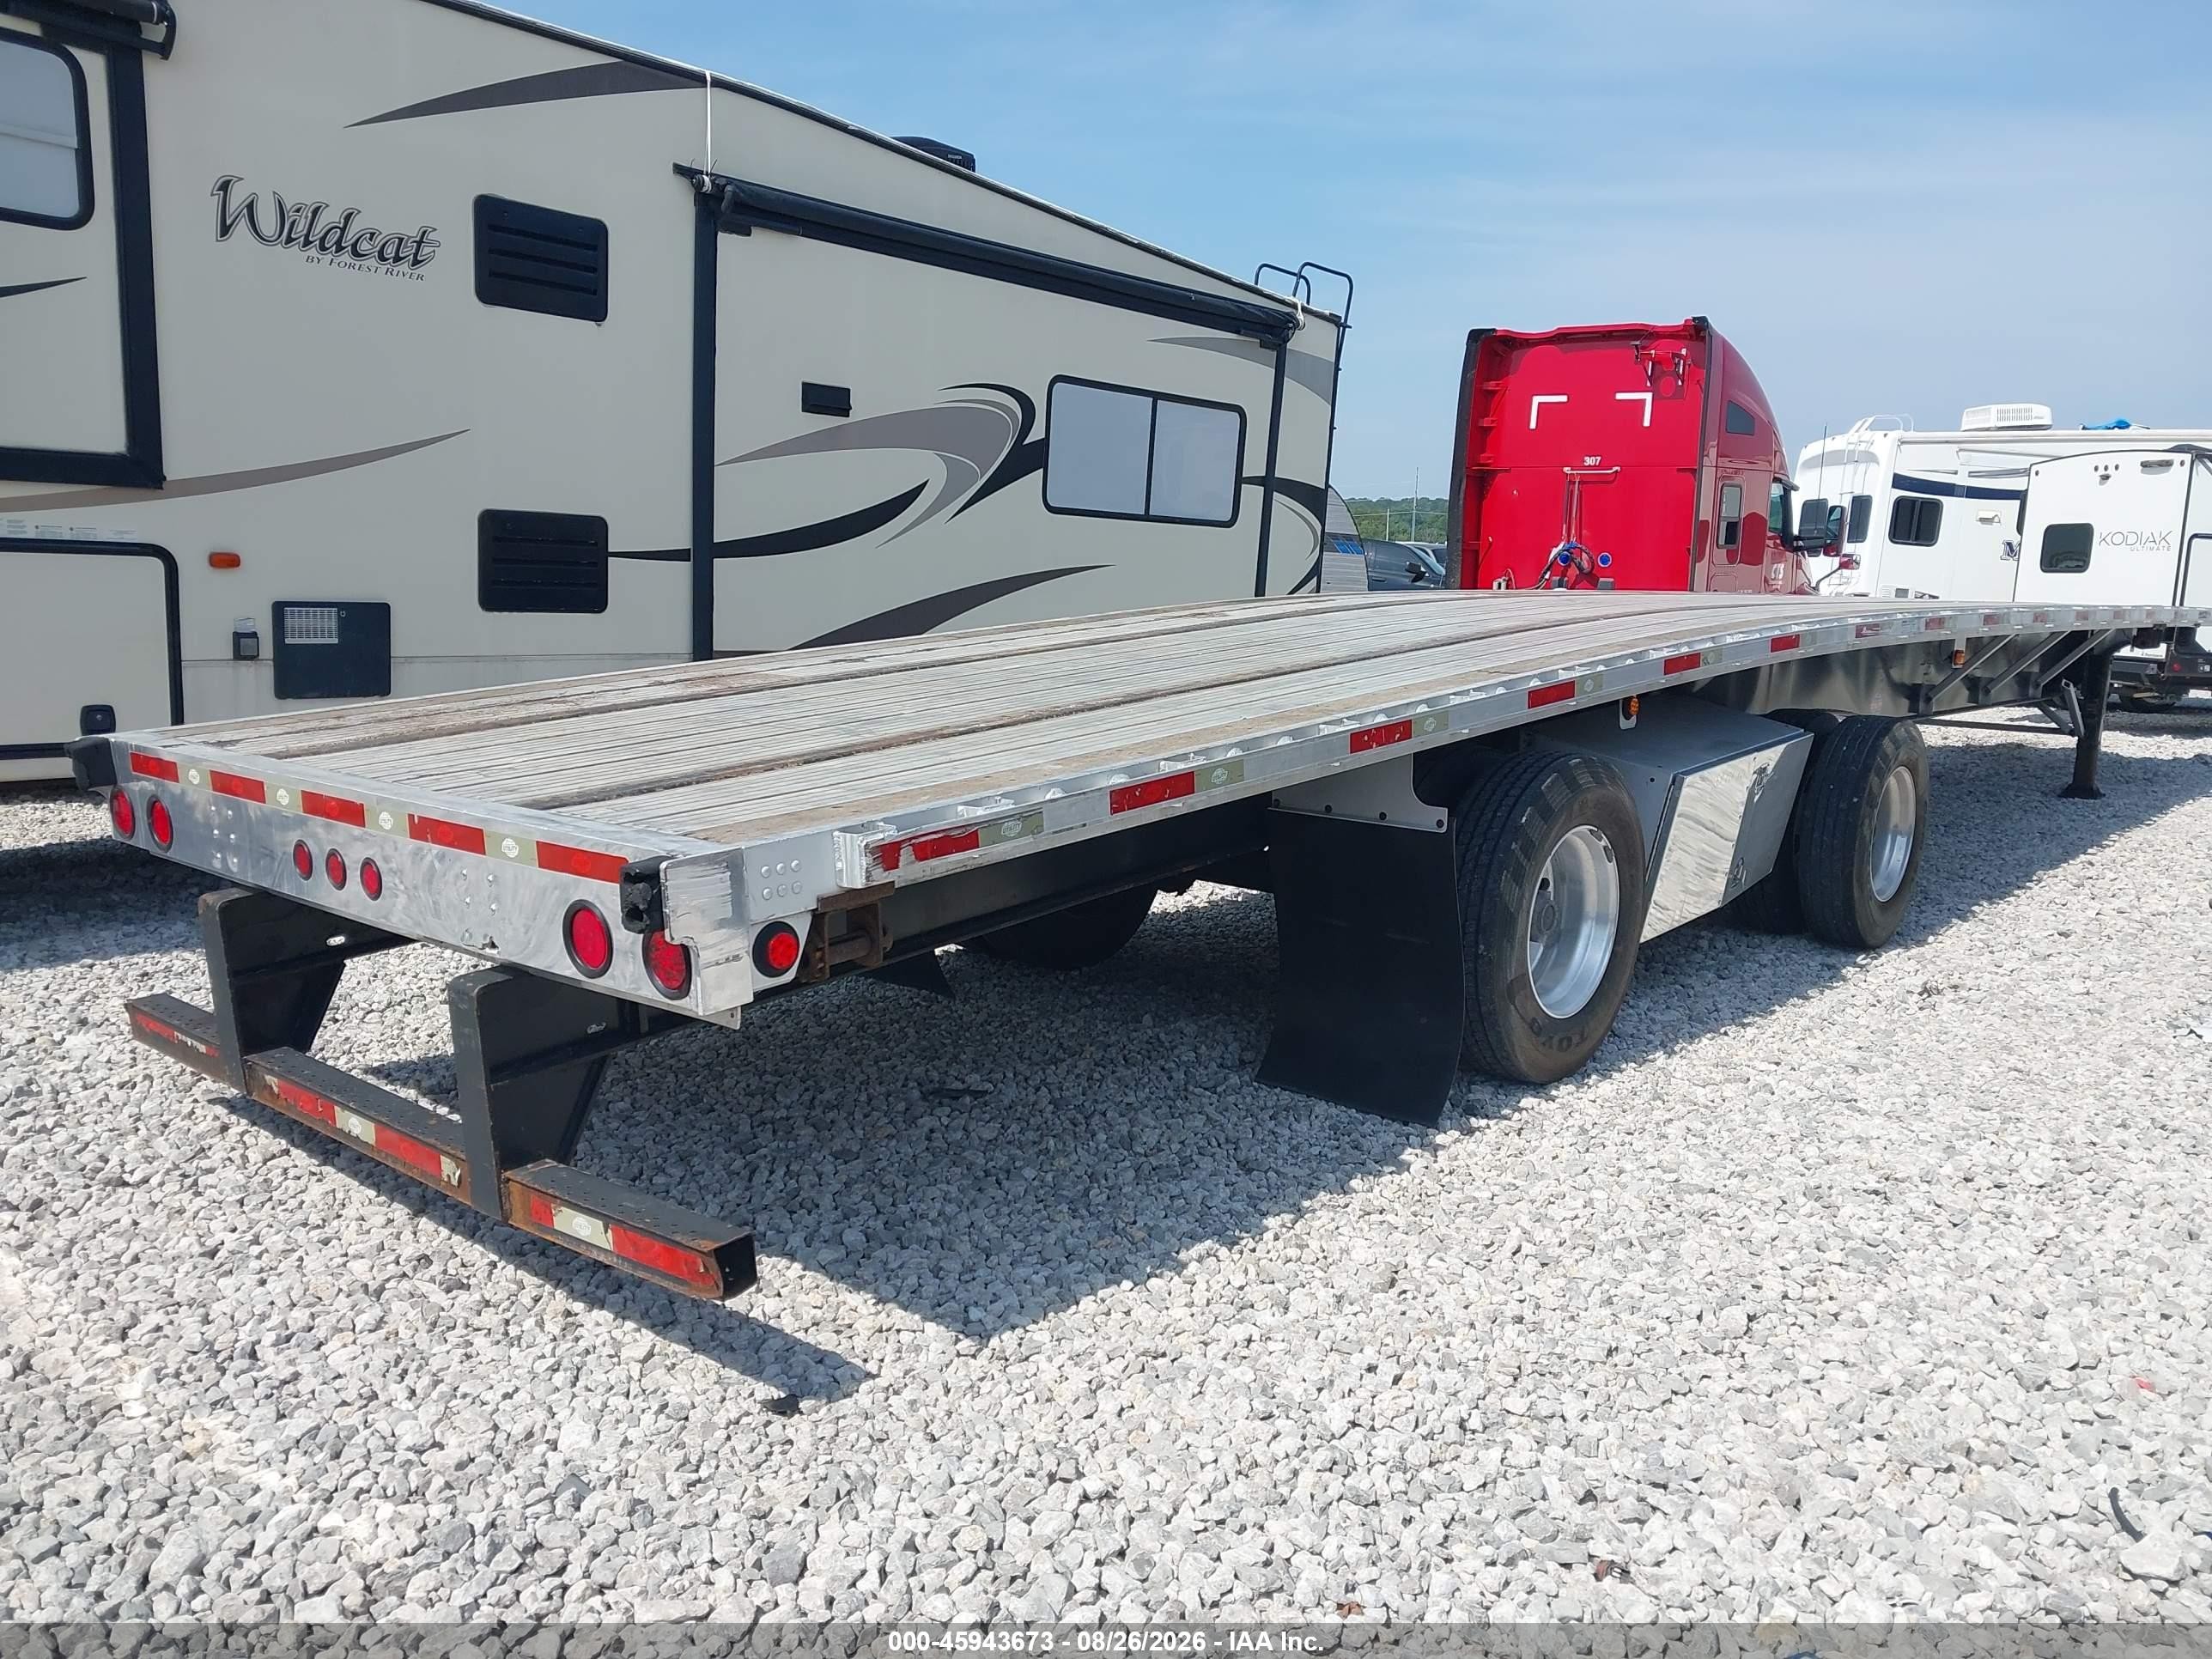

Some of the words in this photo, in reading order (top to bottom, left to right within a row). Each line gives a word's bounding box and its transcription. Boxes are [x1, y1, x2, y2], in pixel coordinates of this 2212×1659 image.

[210, 174, 441, 270] Wildcat
[305, 255, 324, 265] BY
[329, 258, 381, 274] FOREST
[385, 267, 425, 282] RIVER
[1583, 456, 1601, 466] 307
[2099, 530, 2172, 547] KODIAK
